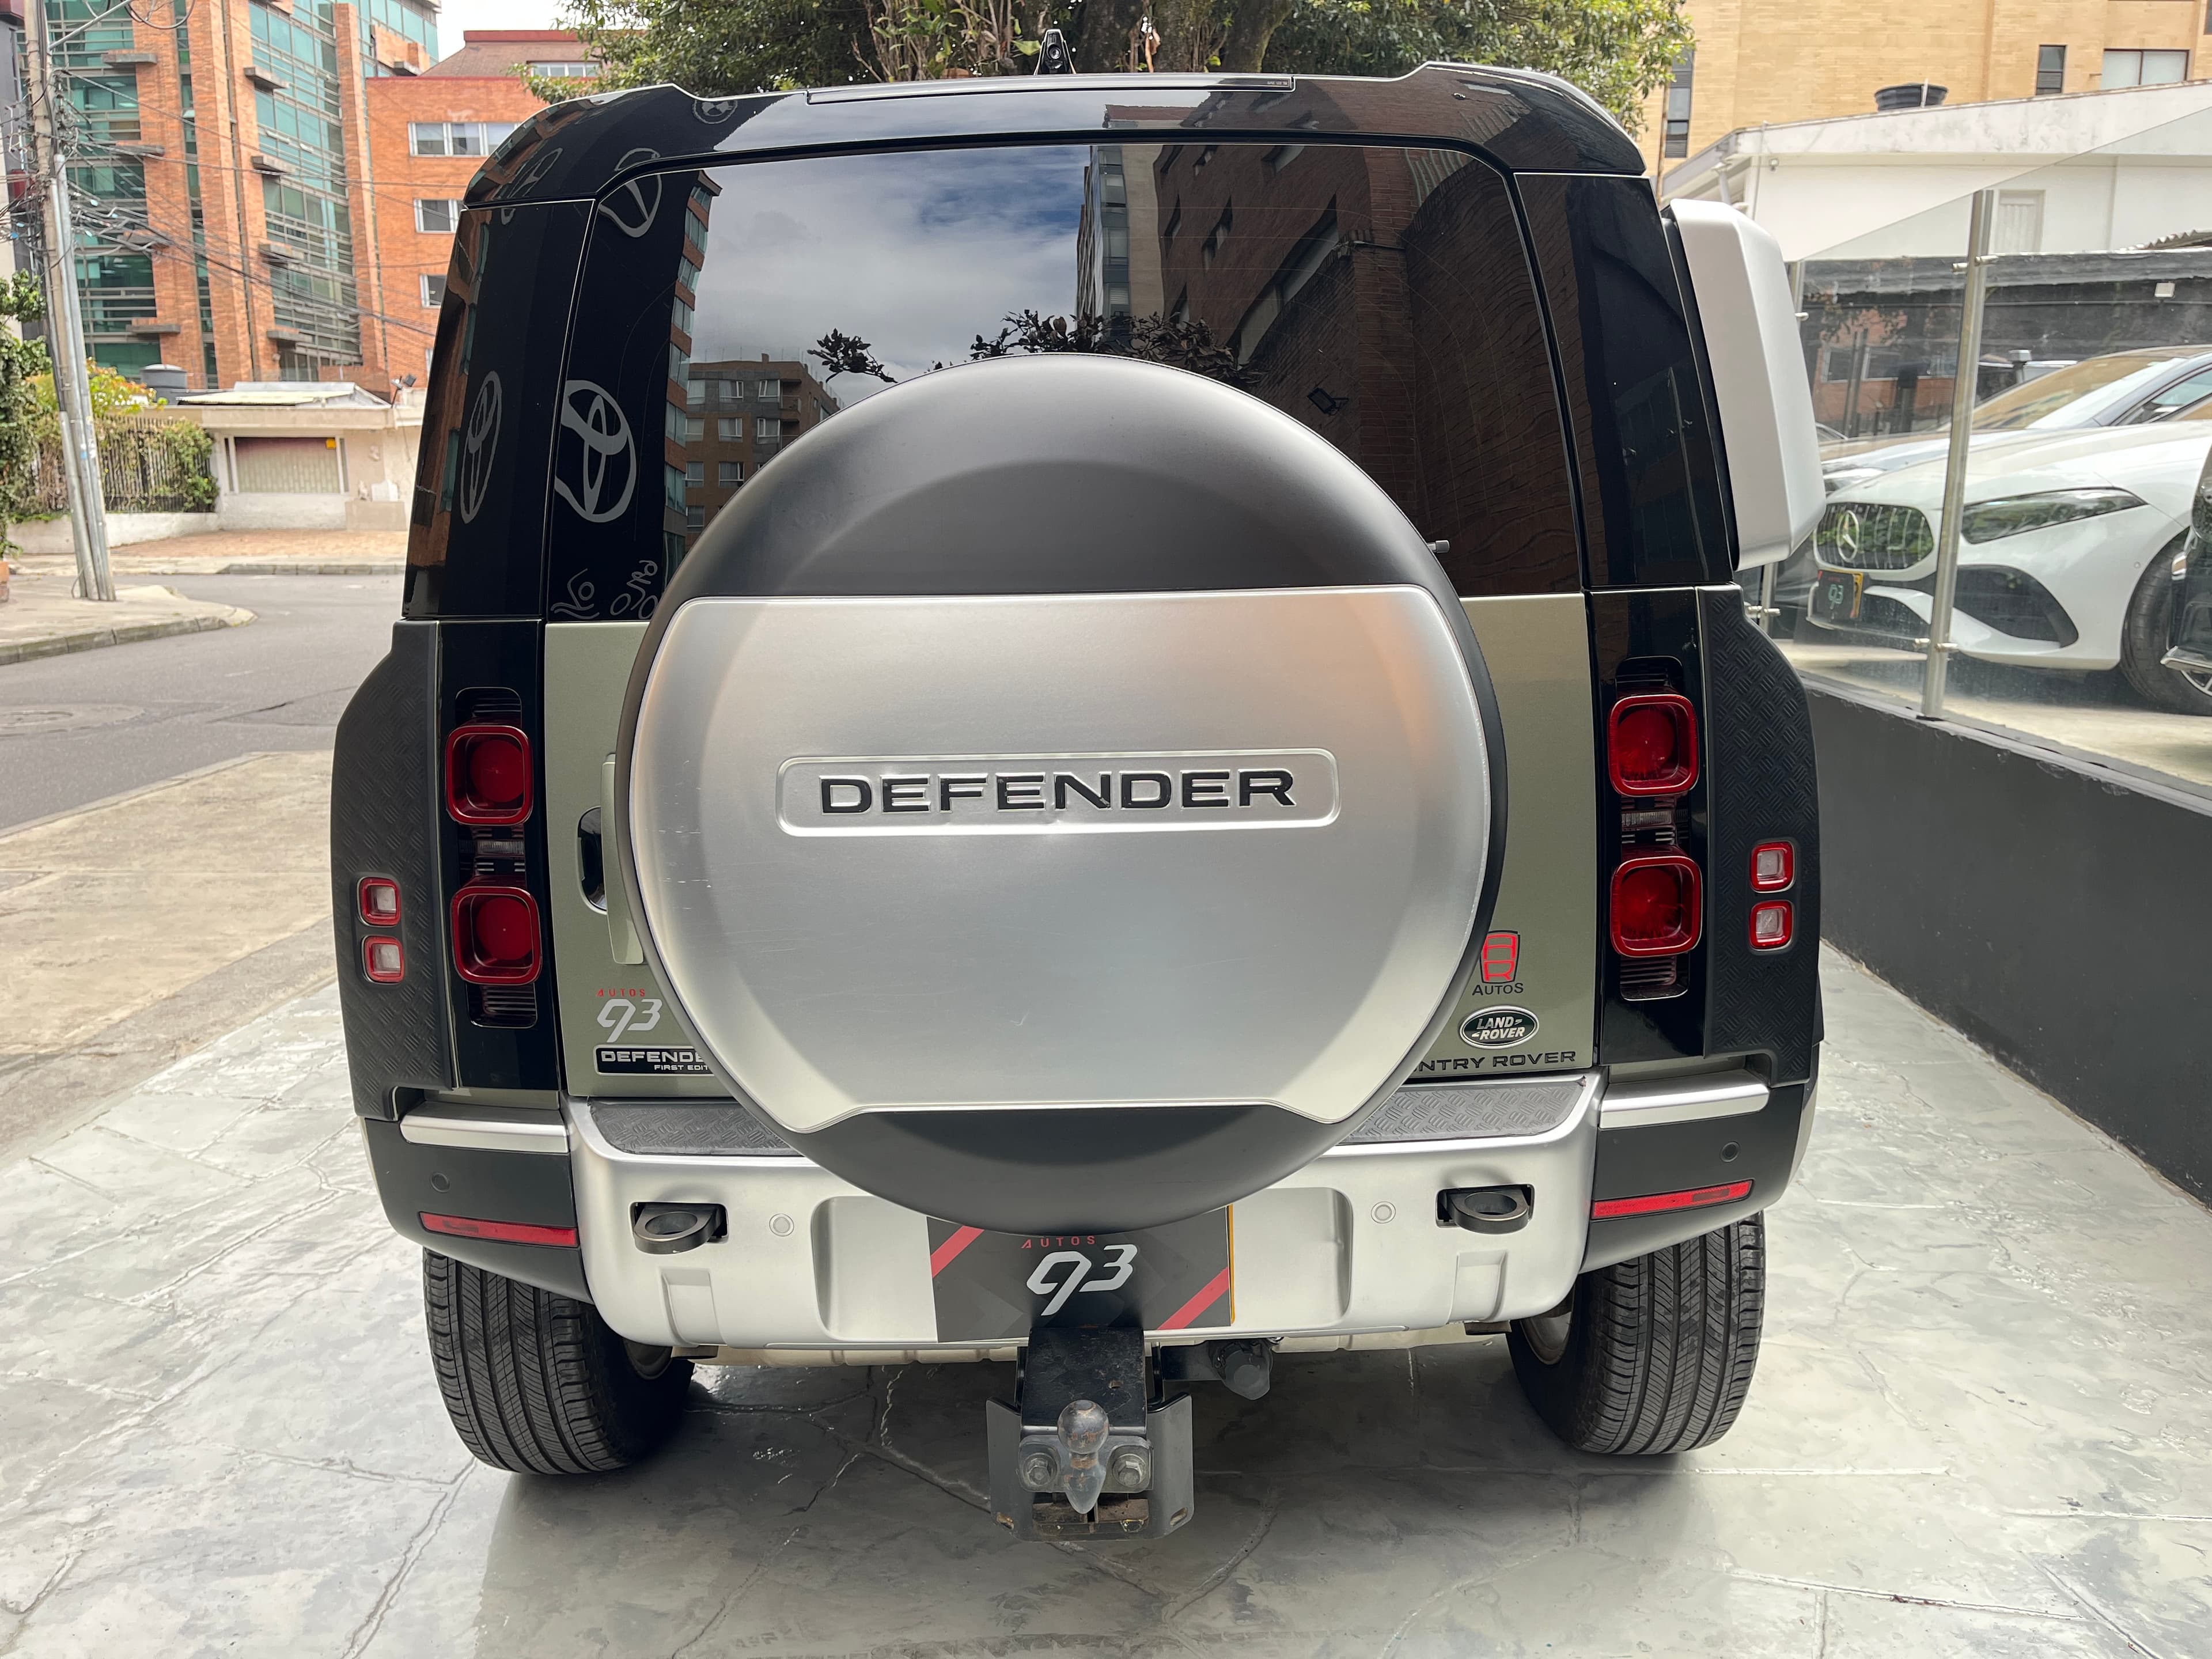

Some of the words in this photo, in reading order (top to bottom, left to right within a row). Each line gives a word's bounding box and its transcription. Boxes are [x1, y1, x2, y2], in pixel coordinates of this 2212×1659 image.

[819, 768, 1297, 814] DEFENDER
[596, 988, 646, 998] AUTOS
[1472, 983, 1524, 996] AUTOS
[597, 998, 663, 1043] 93
[1476, 1016, 1514, 1030] LAND
[1479, 1027, 1525, 1040] ROVER
[1414, 1057, 1485, 1071] NTRY
[1493, 1051, 1576, 1067] ROVER
[1021, 1236, 1096, 1249] AUTOS
[1026, 1244, 1138, 1316] 93
